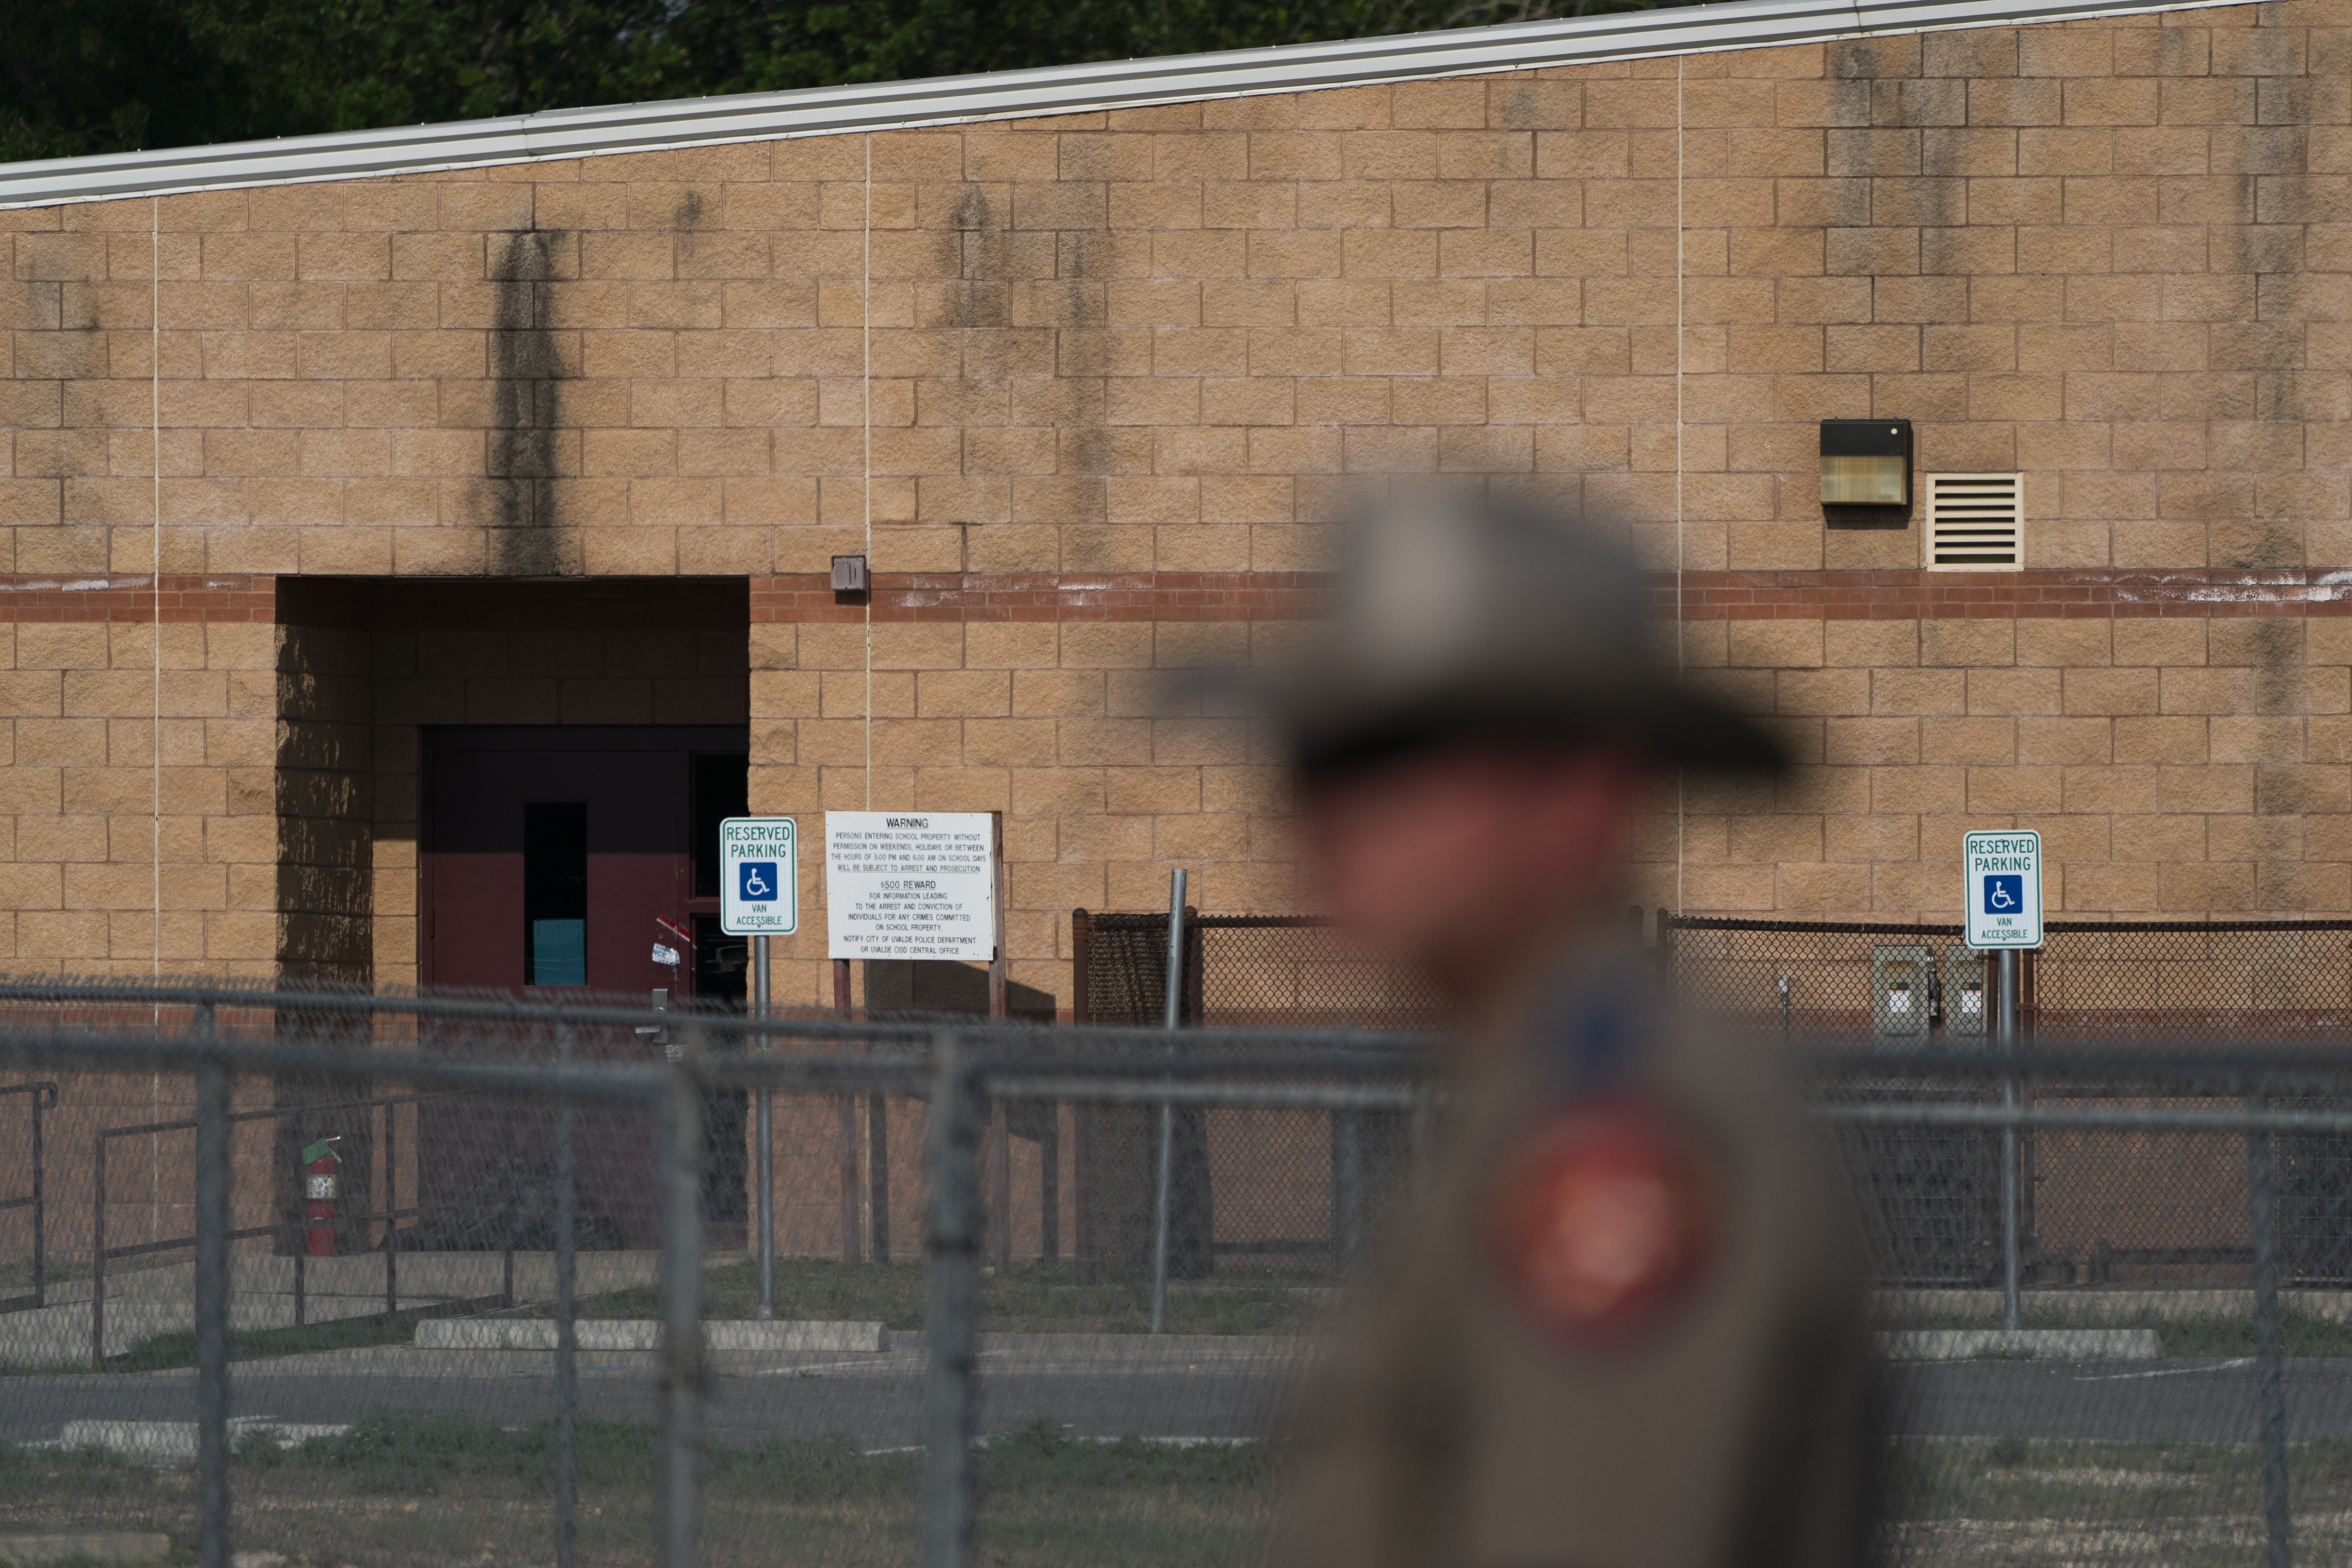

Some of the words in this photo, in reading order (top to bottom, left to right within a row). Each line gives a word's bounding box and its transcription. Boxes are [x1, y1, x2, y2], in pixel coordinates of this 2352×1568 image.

[886, 818, 928, 828] WARNING
[727, 827, 790, 841] RESERVED
[731, 844, 786, 858] PARKING
[1971, 840, 2034, 854] RESERVED
[1975, 857, 2030, 871] PARKING
[752, 904, 767, 913] VAN
[737, 916, 782, 925] ACCESSIBLE
[1996, 918, 2012, 926] VAN
[1981, 930, 2027, 939] ACCESSIBLE
